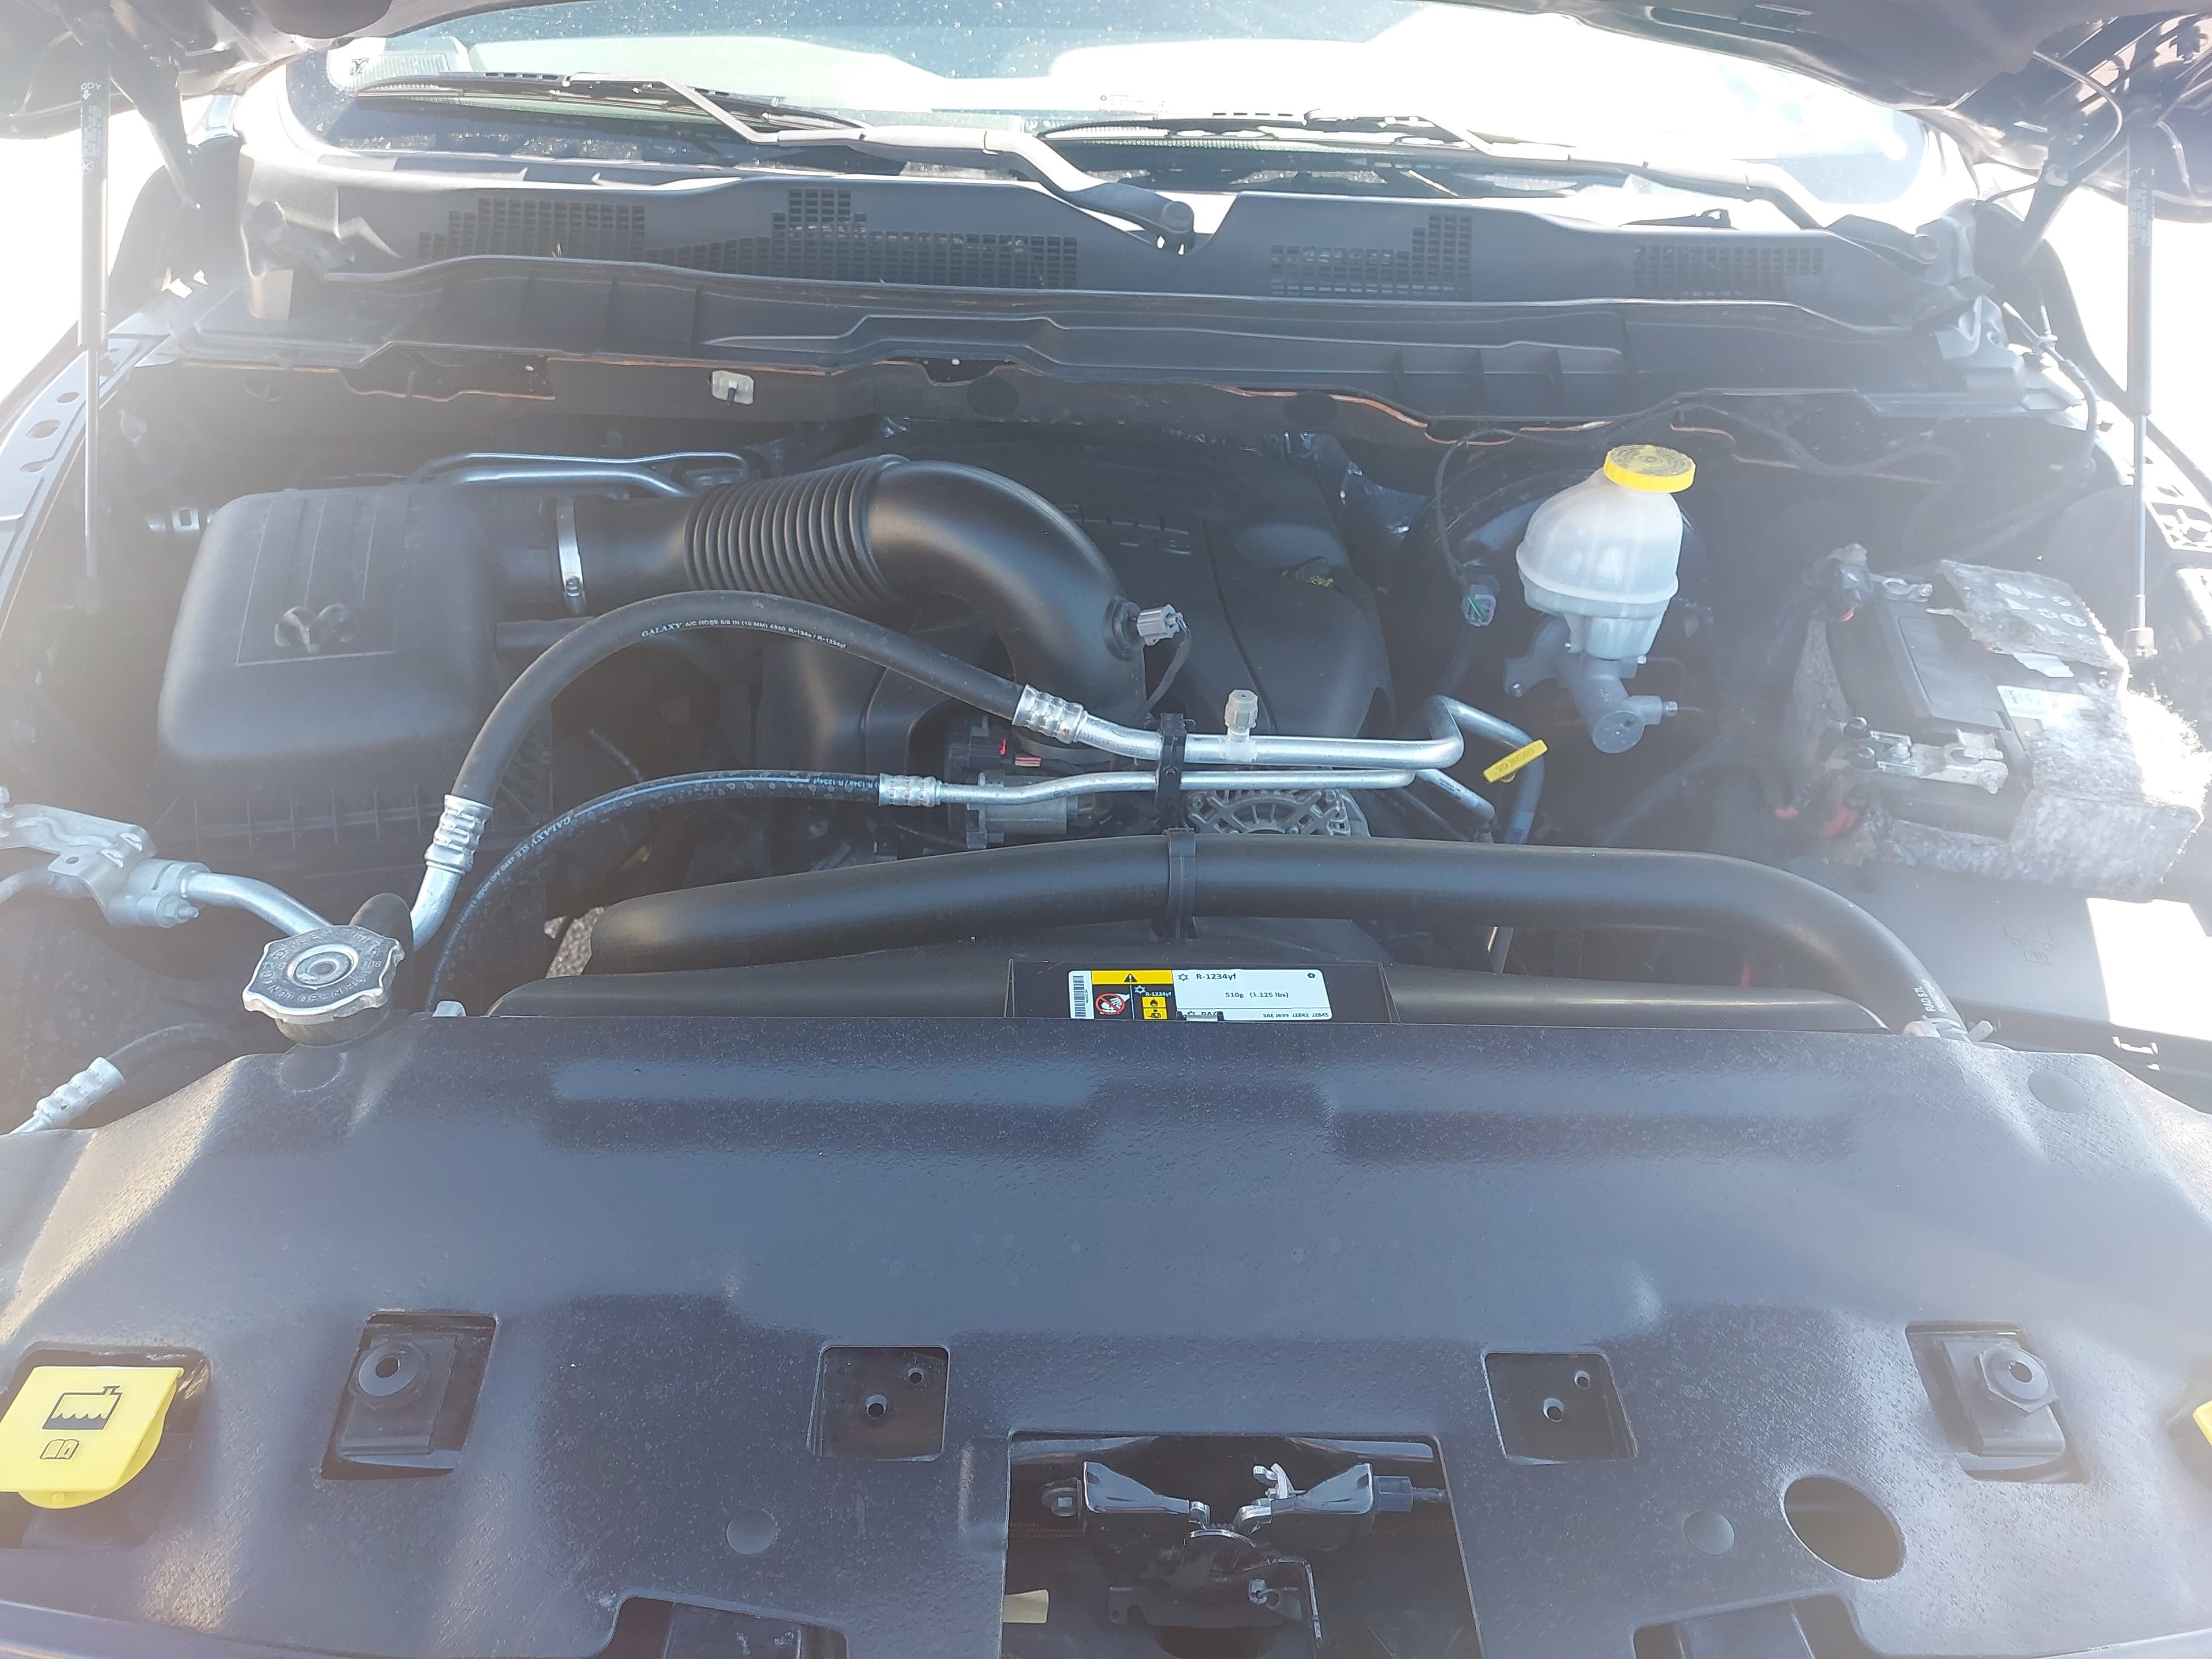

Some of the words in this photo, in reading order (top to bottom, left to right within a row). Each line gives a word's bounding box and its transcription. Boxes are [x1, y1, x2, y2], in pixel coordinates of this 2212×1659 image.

[641, 622, 682, 637] GALAXY
[817, 635, 847, 649] R-1234yf
[813, 777, 844, 787] R-1234yf
[850, 780, 873, 788] R-134a
[531, 816, 571, 847] GALAXY
[1195, 973, 1237, 981] R-1234yf
[268, 985, 295, 1001] NOT
[299, 989, 343, 1002] OPEN
[1921, 997, 1936, 1012] RAD
